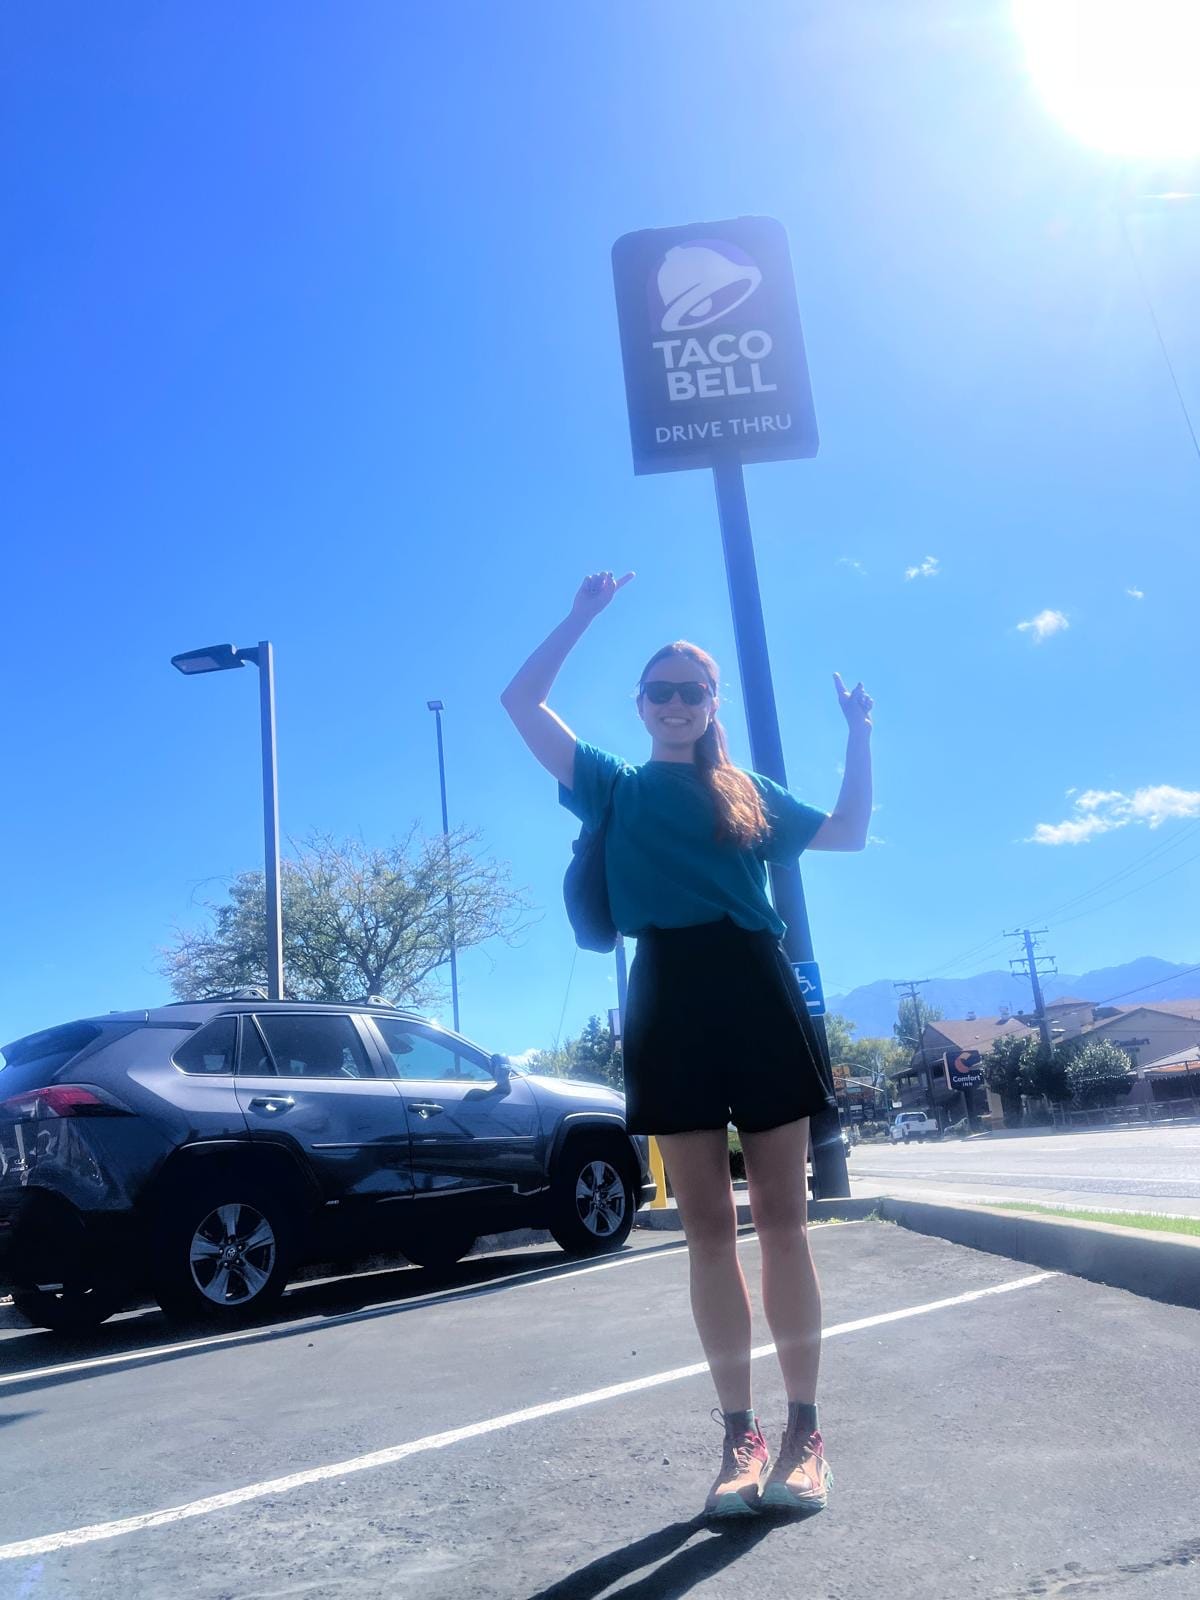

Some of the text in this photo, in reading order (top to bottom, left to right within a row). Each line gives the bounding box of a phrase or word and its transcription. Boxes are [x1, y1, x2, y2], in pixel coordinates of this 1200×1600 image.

[652, 330, 773, 369] TACO
[666, 363, 777, 401] BELL
[655, 413, 792, 443] DRIVE THRU
[952, 1074, 981, 1082] Comfort
